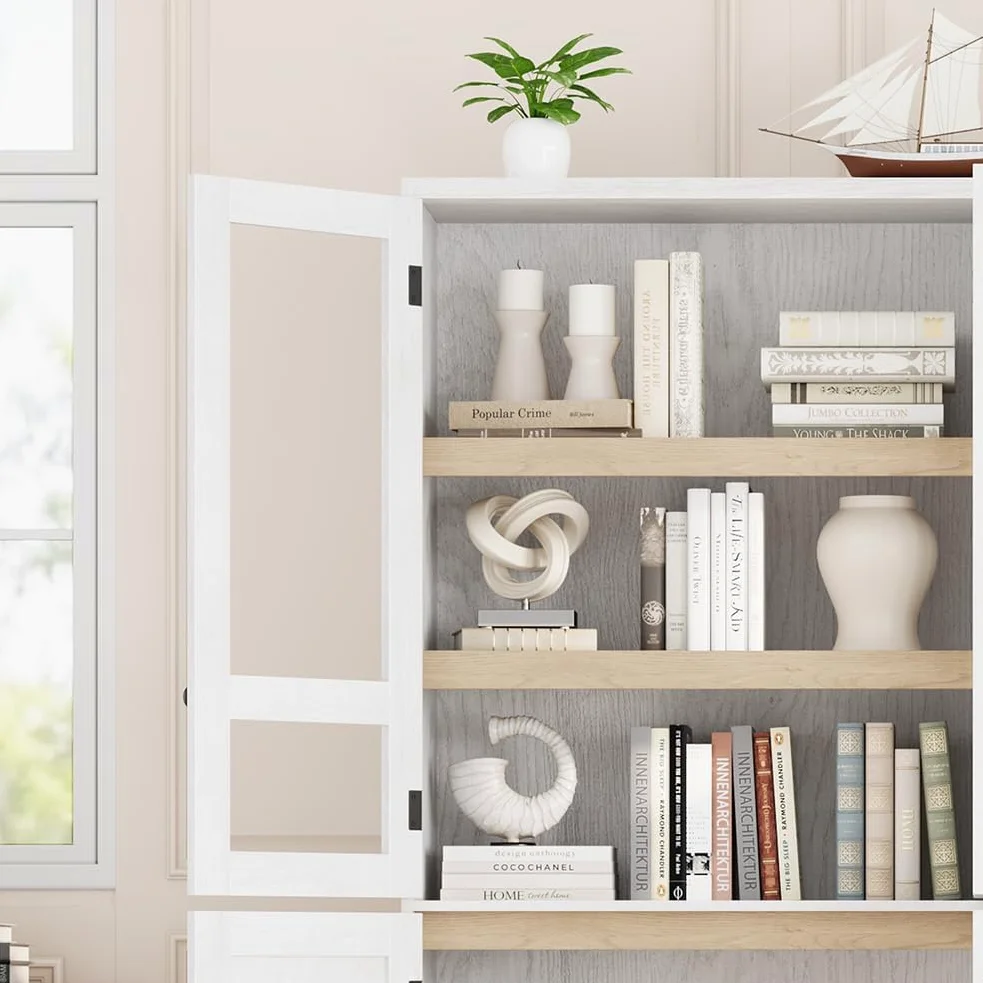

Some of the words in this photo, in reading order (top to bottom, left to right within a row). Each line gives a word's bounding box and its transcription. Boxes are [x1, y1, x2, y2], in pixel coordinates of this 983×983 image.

[471, 408, 515, 421] Popular
[517, 407, 551, 419] Crime
[808, 407, 842, 419] JUMBO
[844, 407, 908, 418] COLLECTION
[792, 428, 836, 438] YOUNG
[846, 428, 869, 438] THE
[872, 428, 910, 438] SHACK
[777, 751, 785, 790] CHANDLER
[635, 752, 649, 892] INNENARCHITEKTUR
[716, 757, 729, 892] INNENARCHITEKTUR
[737, 751, 758, 891] INNENARCHITEKTUR
[779, 793, 787, 830] RAYMOND
[483, 890, 524, 900] HOME
